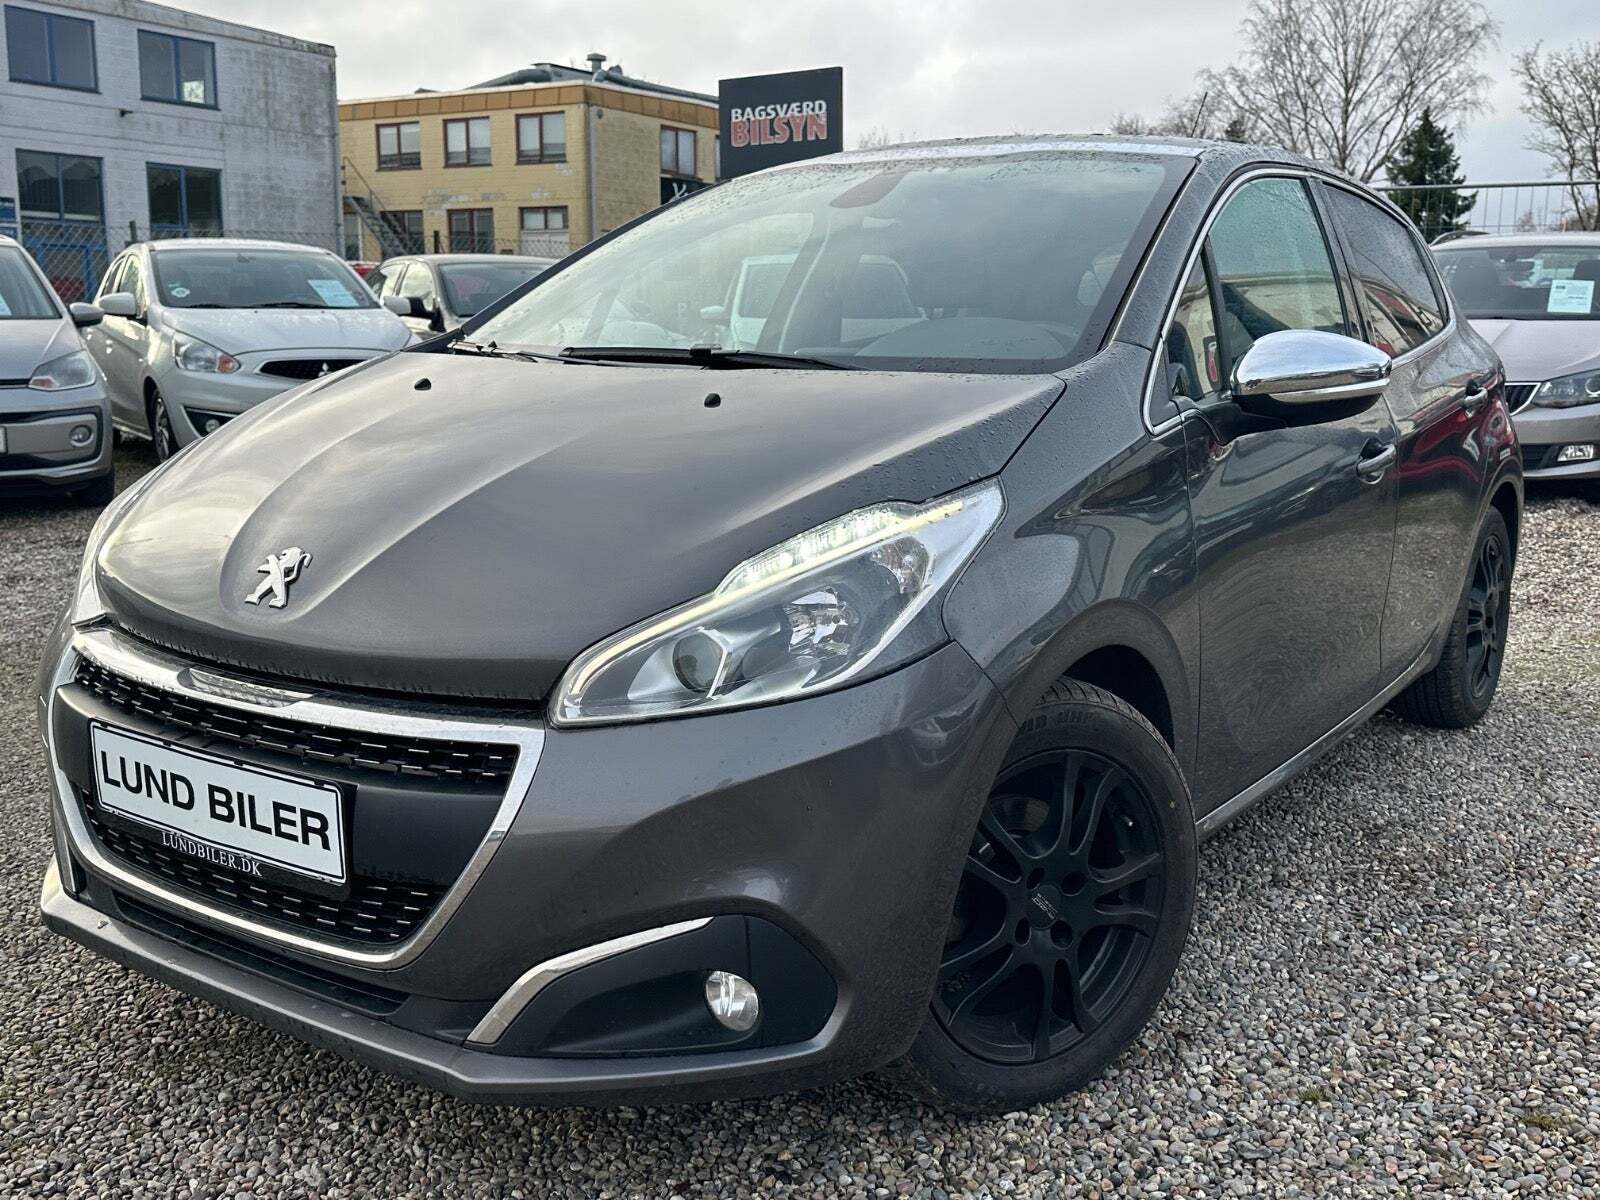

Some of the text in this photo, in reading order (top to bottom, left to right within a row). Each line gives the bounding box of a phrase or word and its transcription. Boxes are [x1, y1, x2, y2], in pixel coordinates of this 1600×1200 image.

[731, 100, 827, 121] BAGSVÆRD
[731, 112, 827, 147] BILSYN
[101, 750, 330, 851] LUND BILER
[162, 832, 263, 878] LUNDBILER.DK
